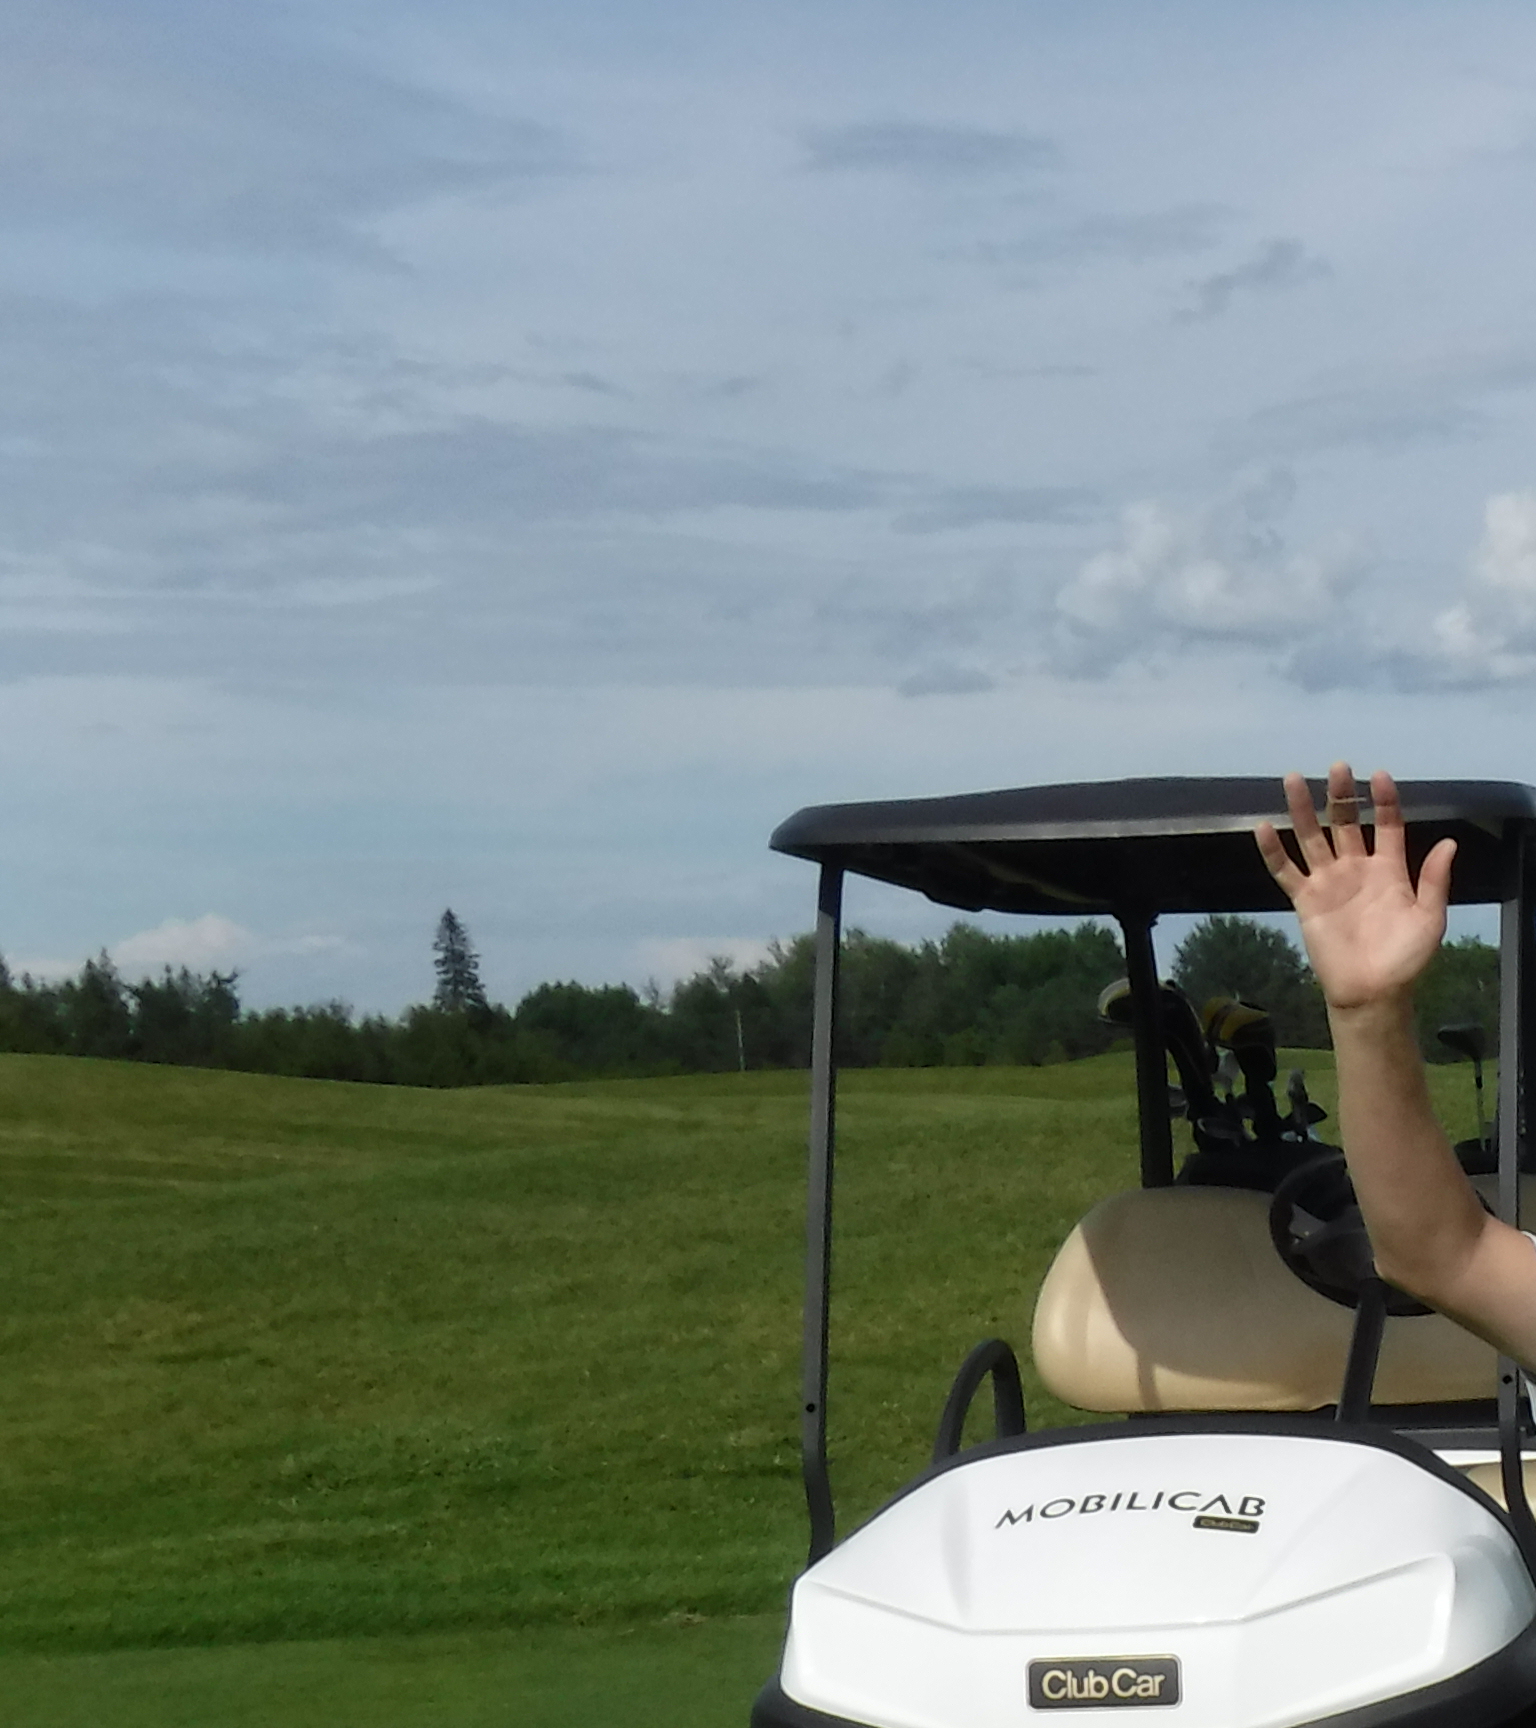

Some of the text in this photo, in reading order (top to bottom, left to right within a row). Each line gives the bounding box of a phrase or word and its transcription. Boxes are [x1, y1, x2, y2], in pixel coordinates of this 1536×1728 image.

[995, 1491, 1266, 1529] MOBILICAB
[1041, 1667, 1166, 1700] Club Car
